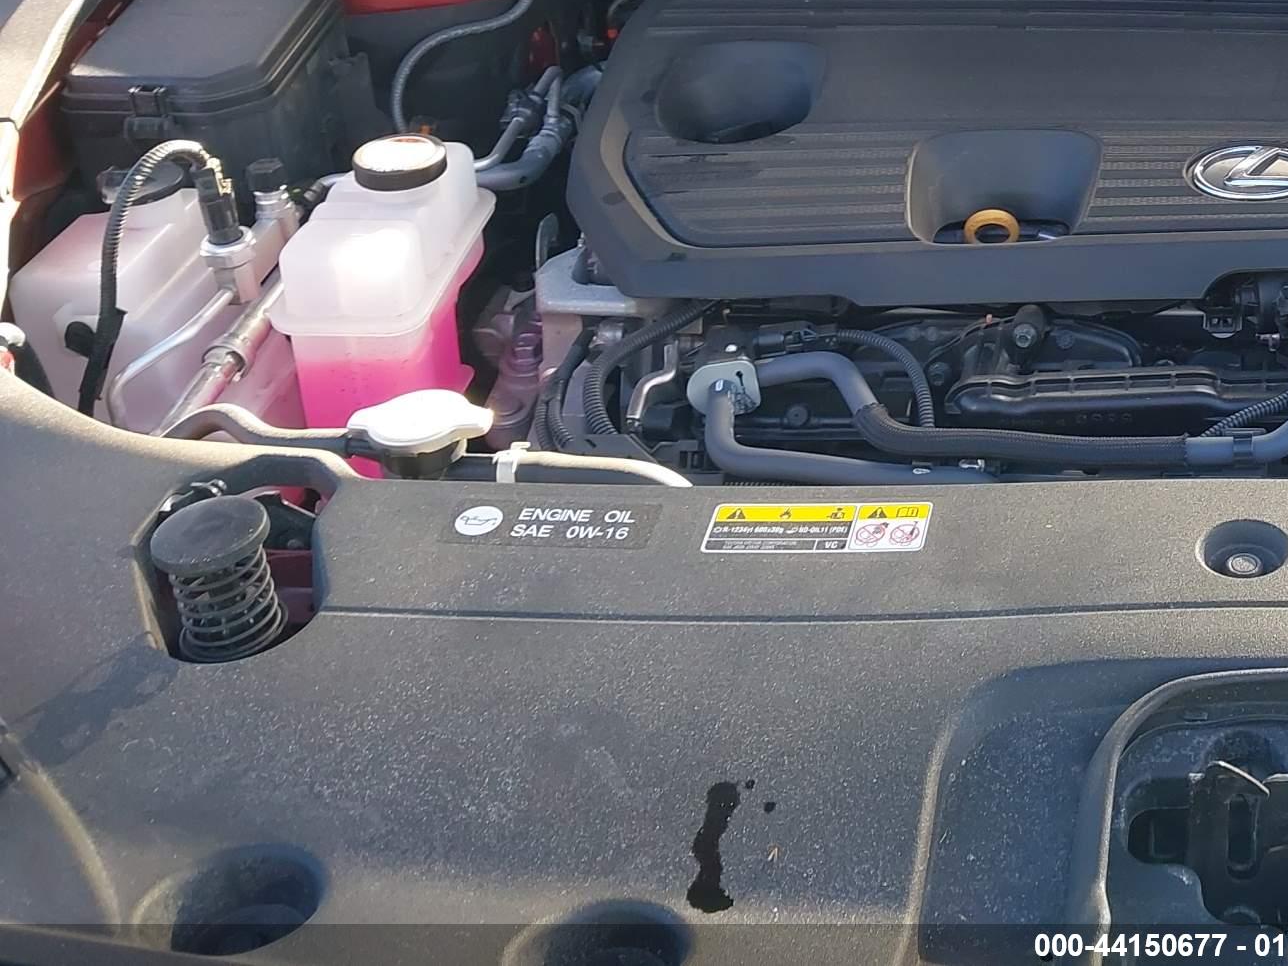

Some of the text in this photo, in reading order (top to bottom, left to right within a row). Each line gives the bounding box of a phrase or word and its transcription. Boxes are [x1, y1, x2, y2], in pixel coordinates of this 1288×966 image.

[518, 508, 635, 523] ENGINE OIL
[510, 524, 629, 540] SAE 0W-16
[824, 540, 839, 549] VC
